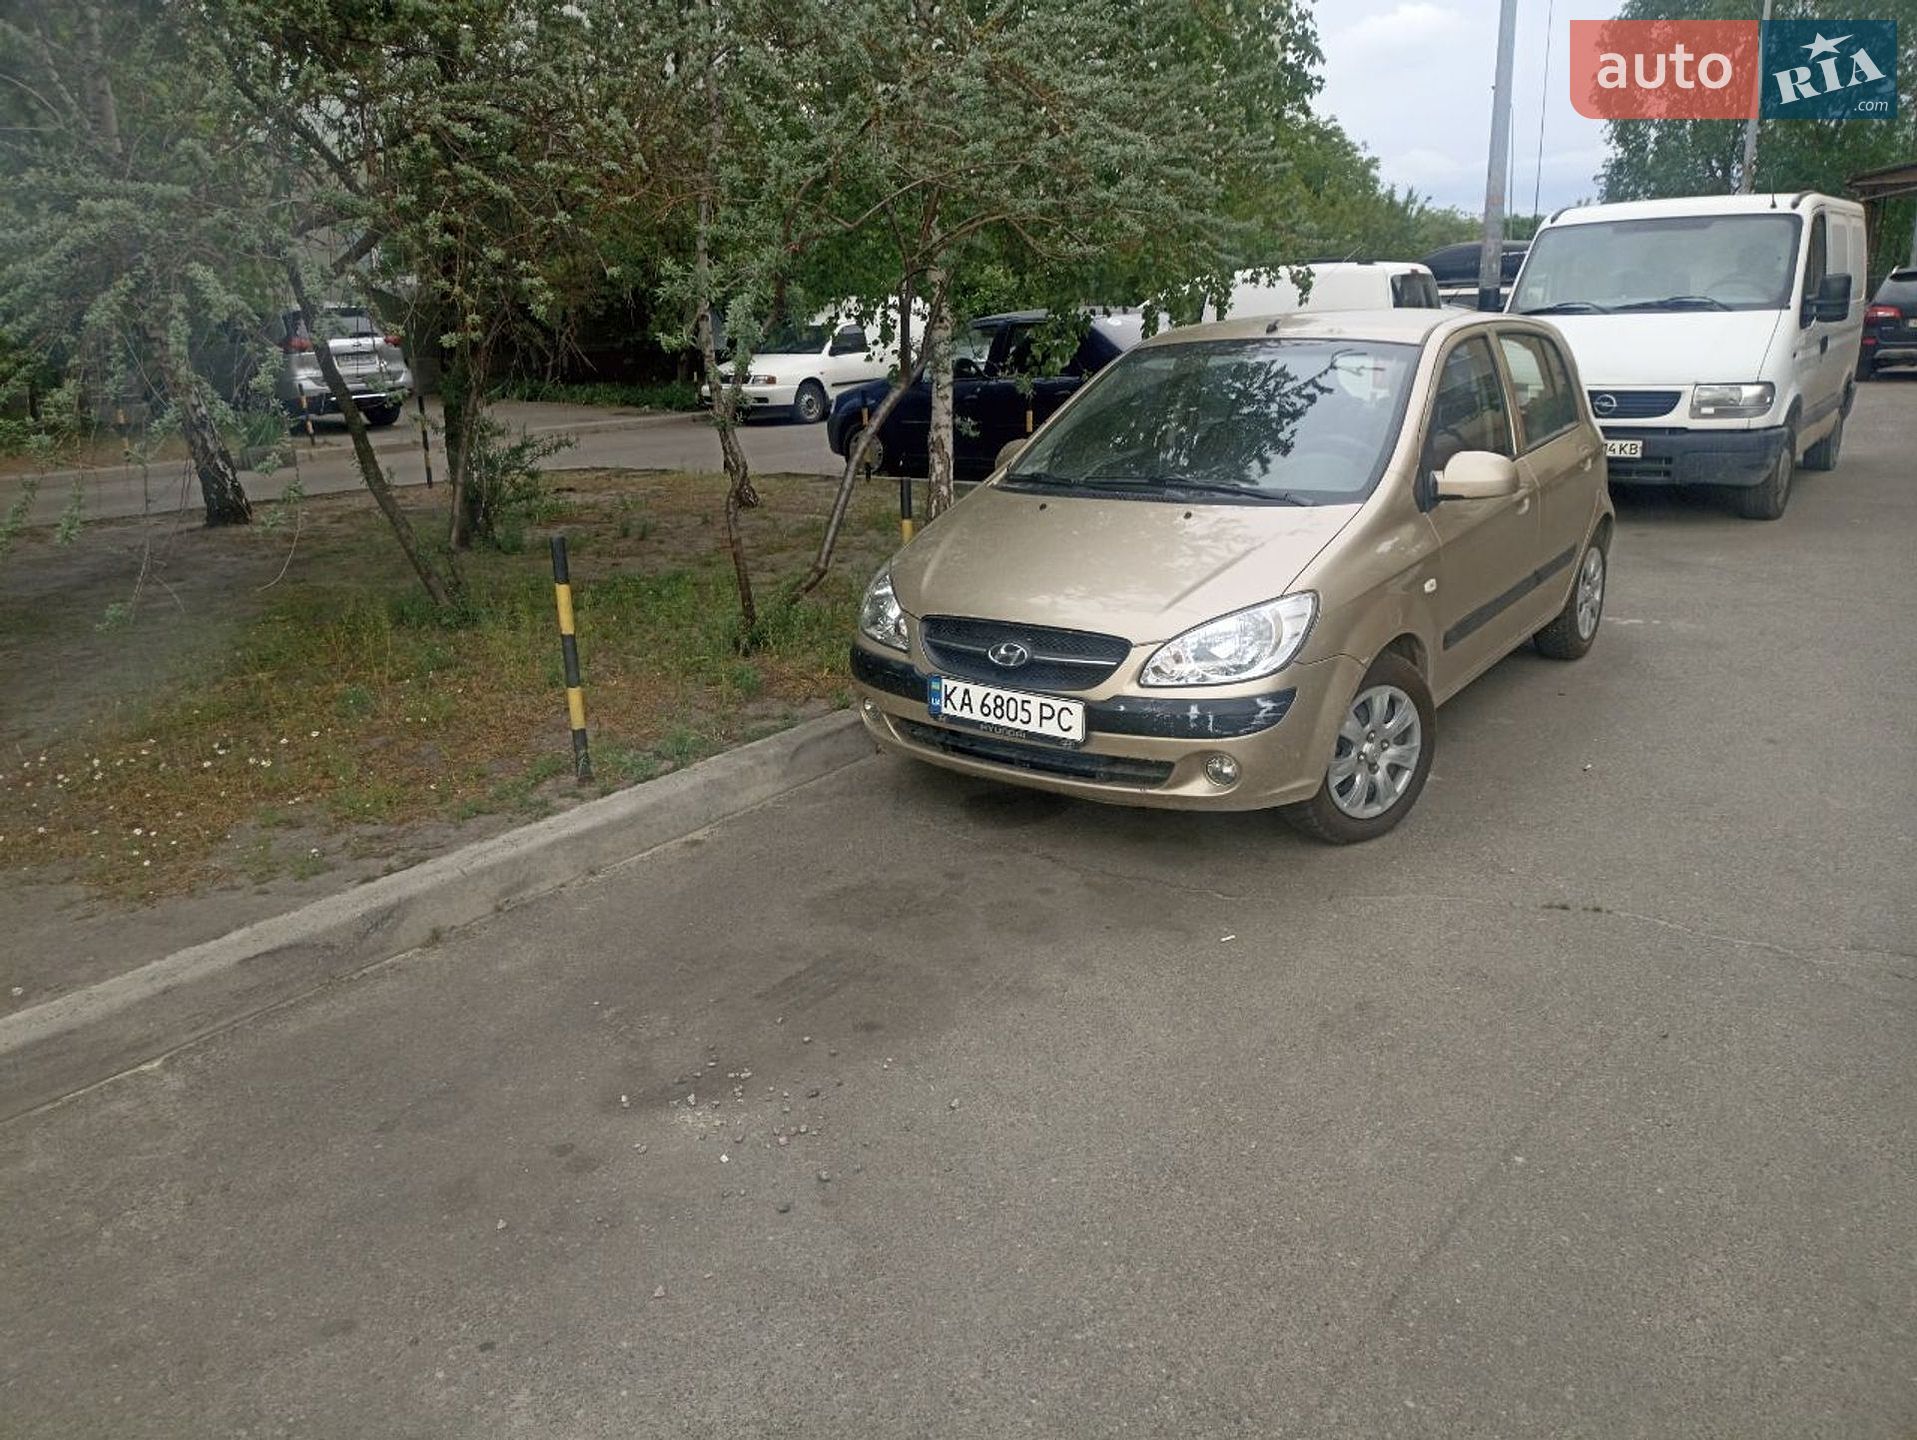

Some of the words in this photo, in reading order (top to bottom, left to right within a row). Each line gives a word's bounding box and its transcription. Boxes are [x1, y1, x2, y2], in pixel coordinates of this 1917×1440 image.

[1619, 443, 1640, 456] KB
[943, 684, 973, 714] KA
[979, 692, 1032, 724] 6805
[1039, 703, 1073, 732] PC
